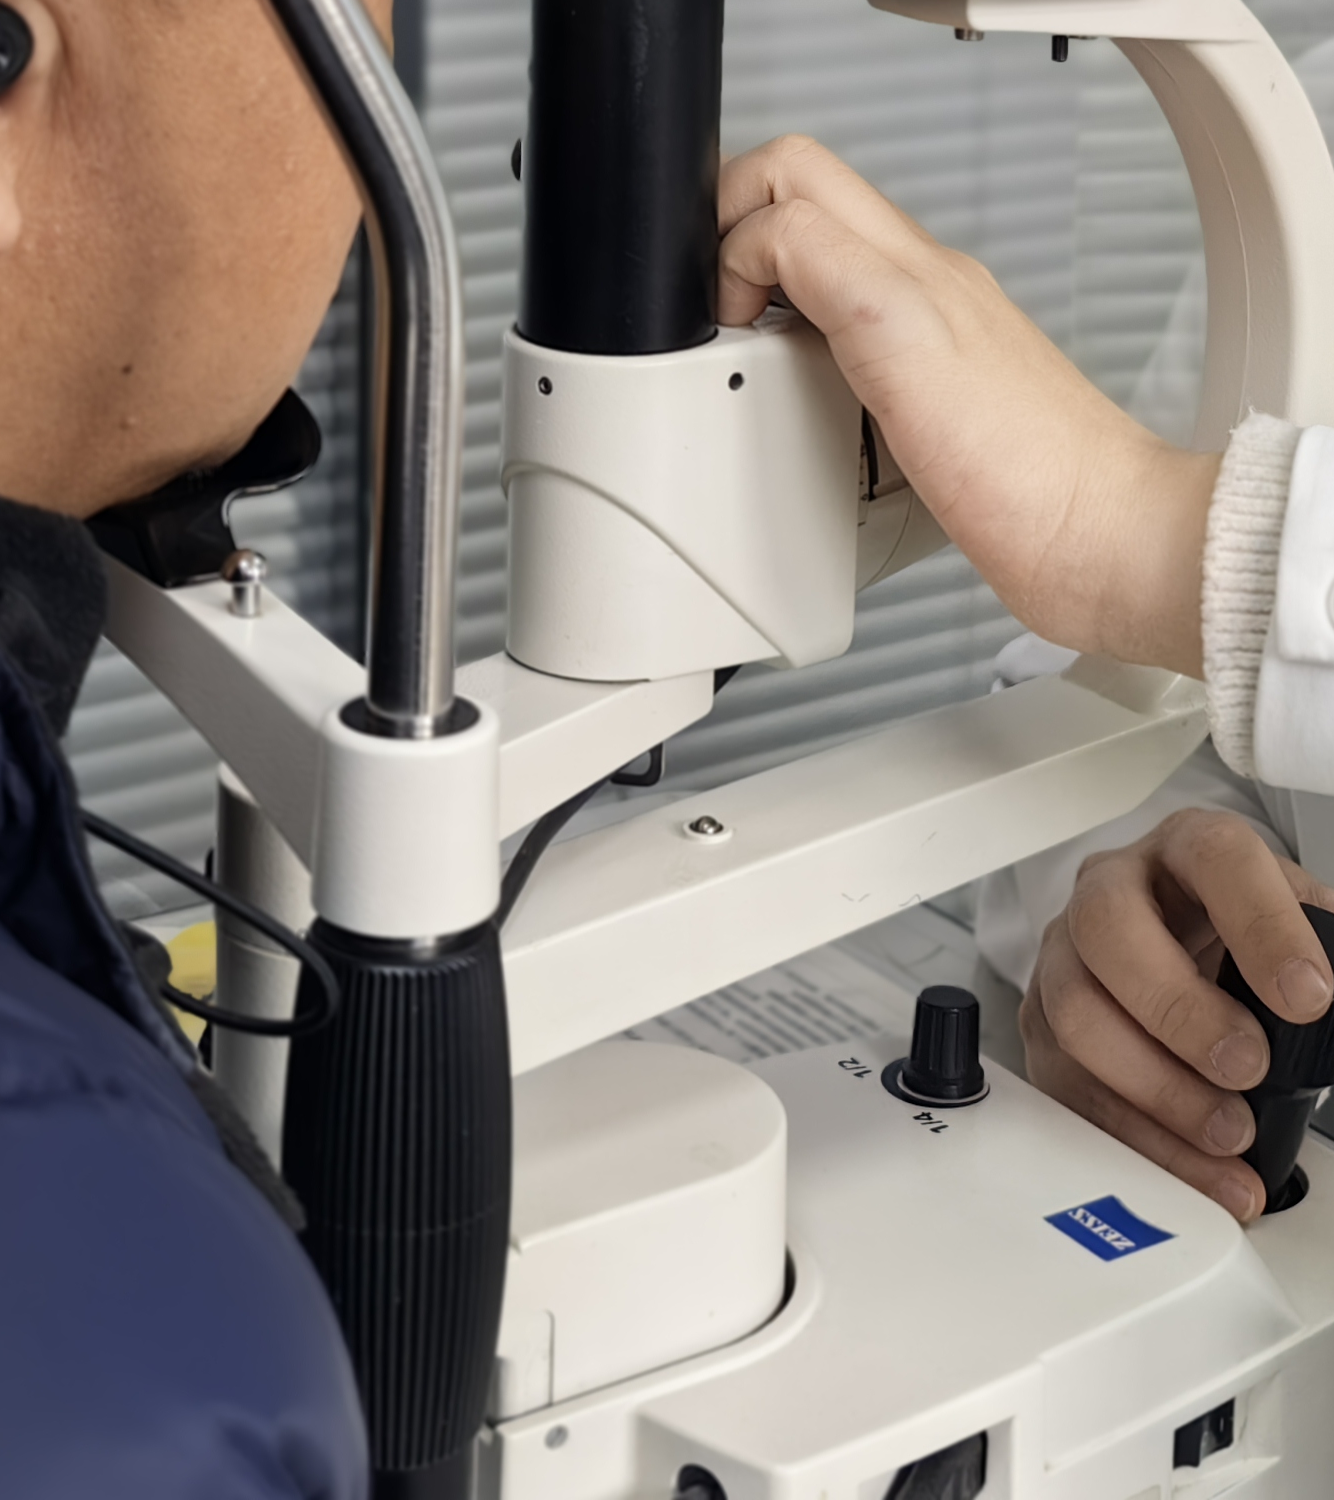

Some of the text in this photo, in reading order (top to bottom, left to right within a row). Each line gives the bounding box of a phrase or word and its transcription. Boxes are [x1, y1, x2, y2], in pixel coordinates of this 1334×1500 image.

[838, 1057, 873, 1079] 1/2
[912, 1112, 949, 1134] 1/4
[1067, 1207, 1137, 1252] ZEISS
